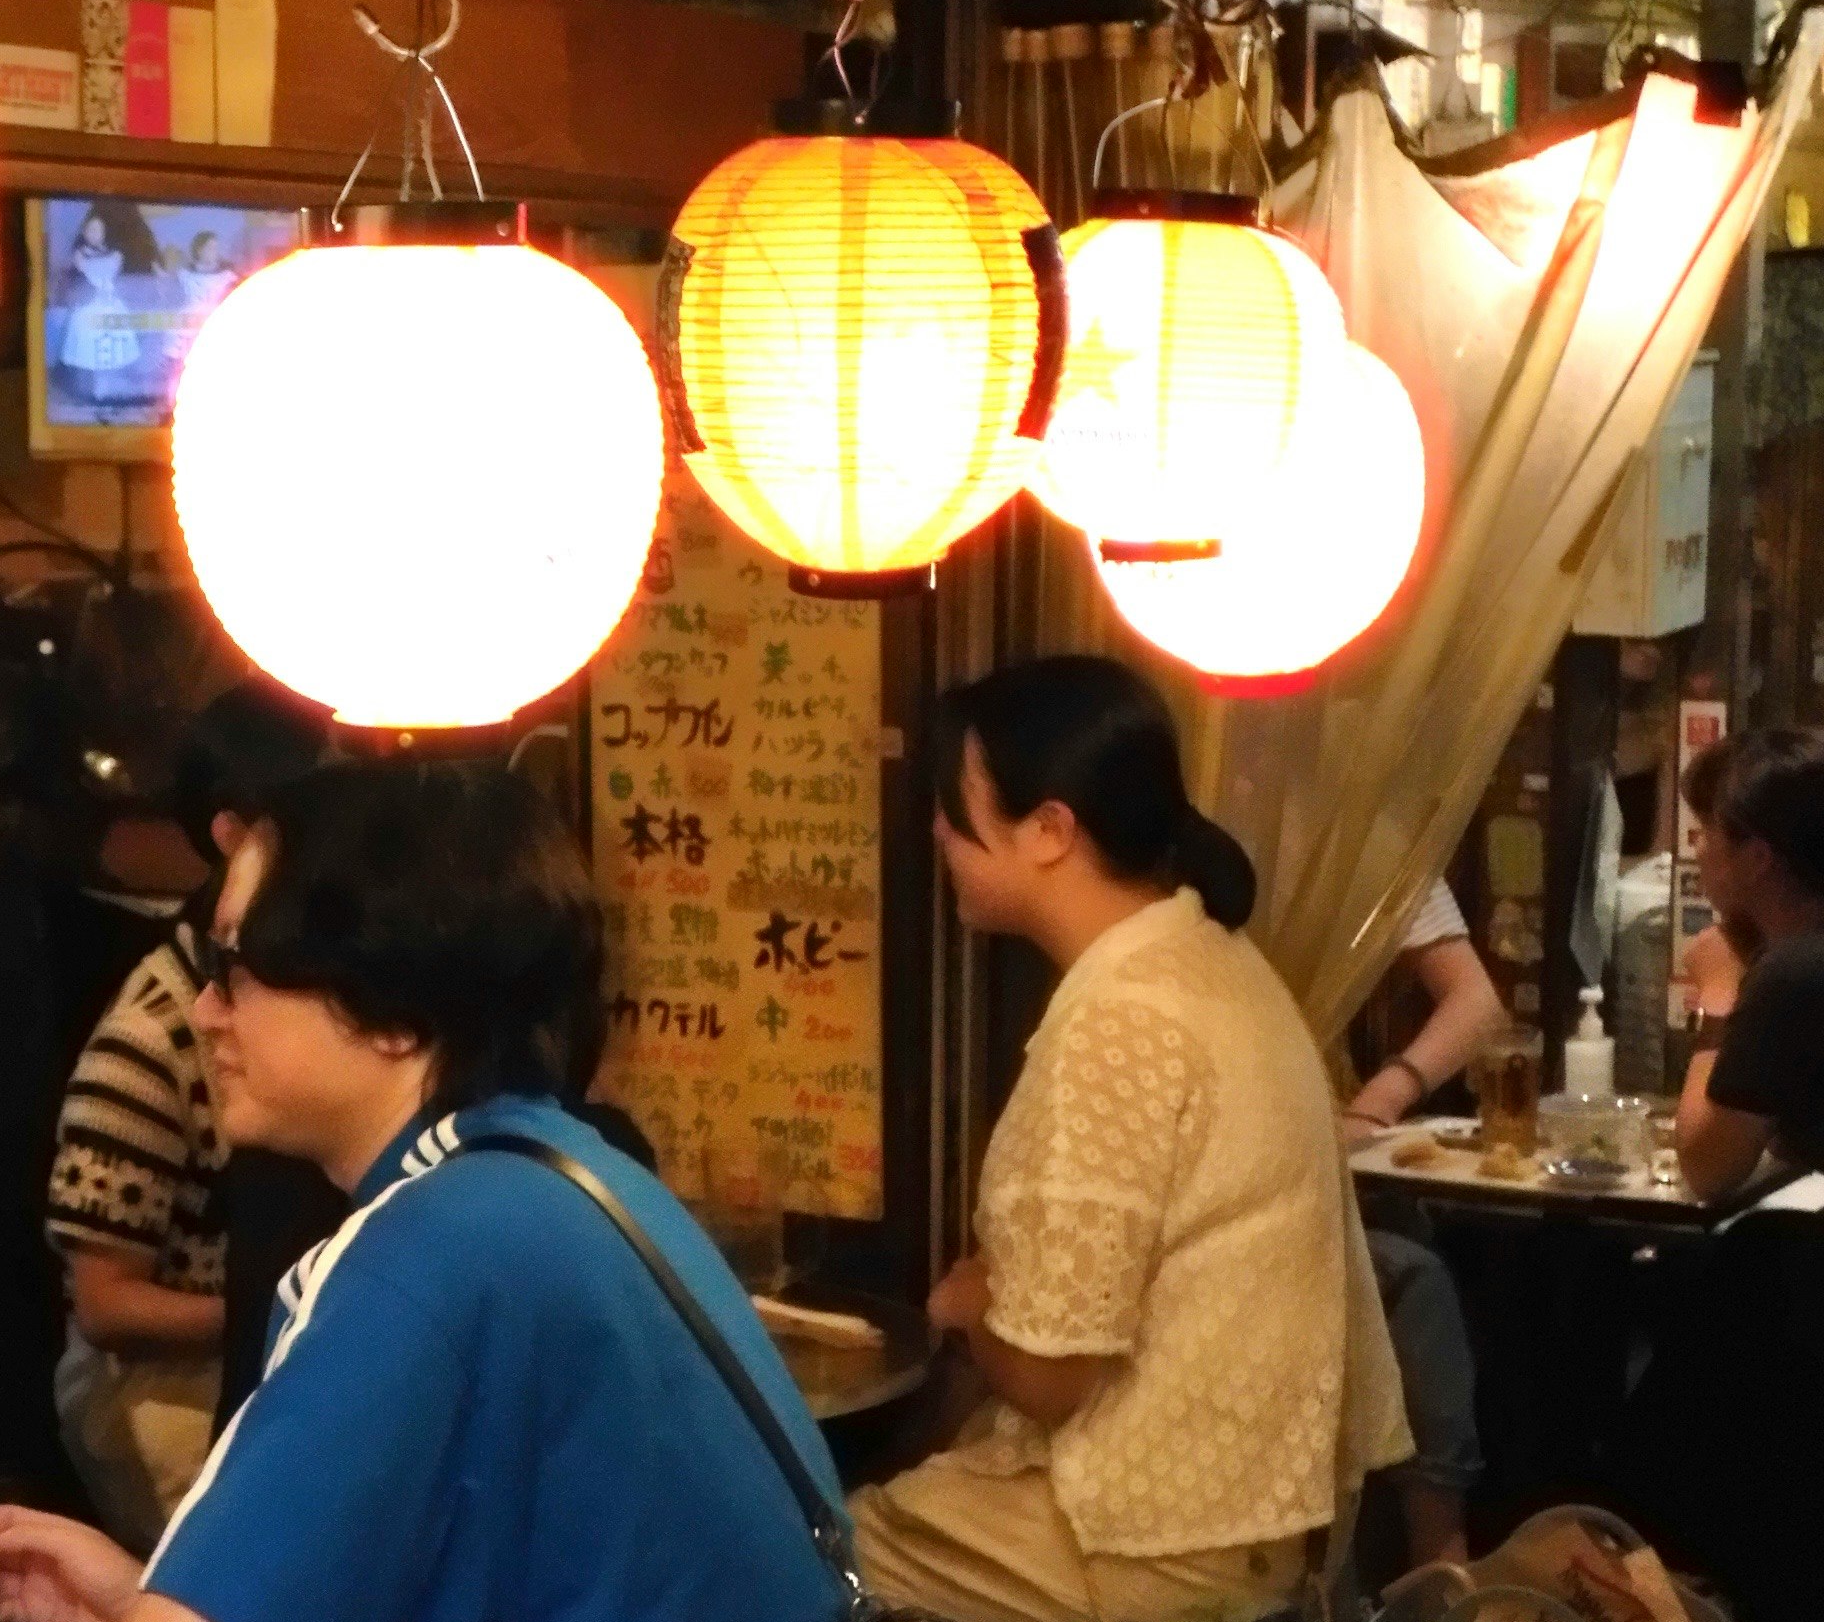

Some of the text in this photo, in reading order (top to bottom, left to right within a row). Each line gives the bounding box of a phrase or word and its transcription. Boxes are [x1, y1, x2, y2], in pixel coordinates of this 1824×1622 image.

[619, 800, 713, 867] 本格
[606, 990, 727, 1041] カクテル
[755, 994, 791, 1043] 中
